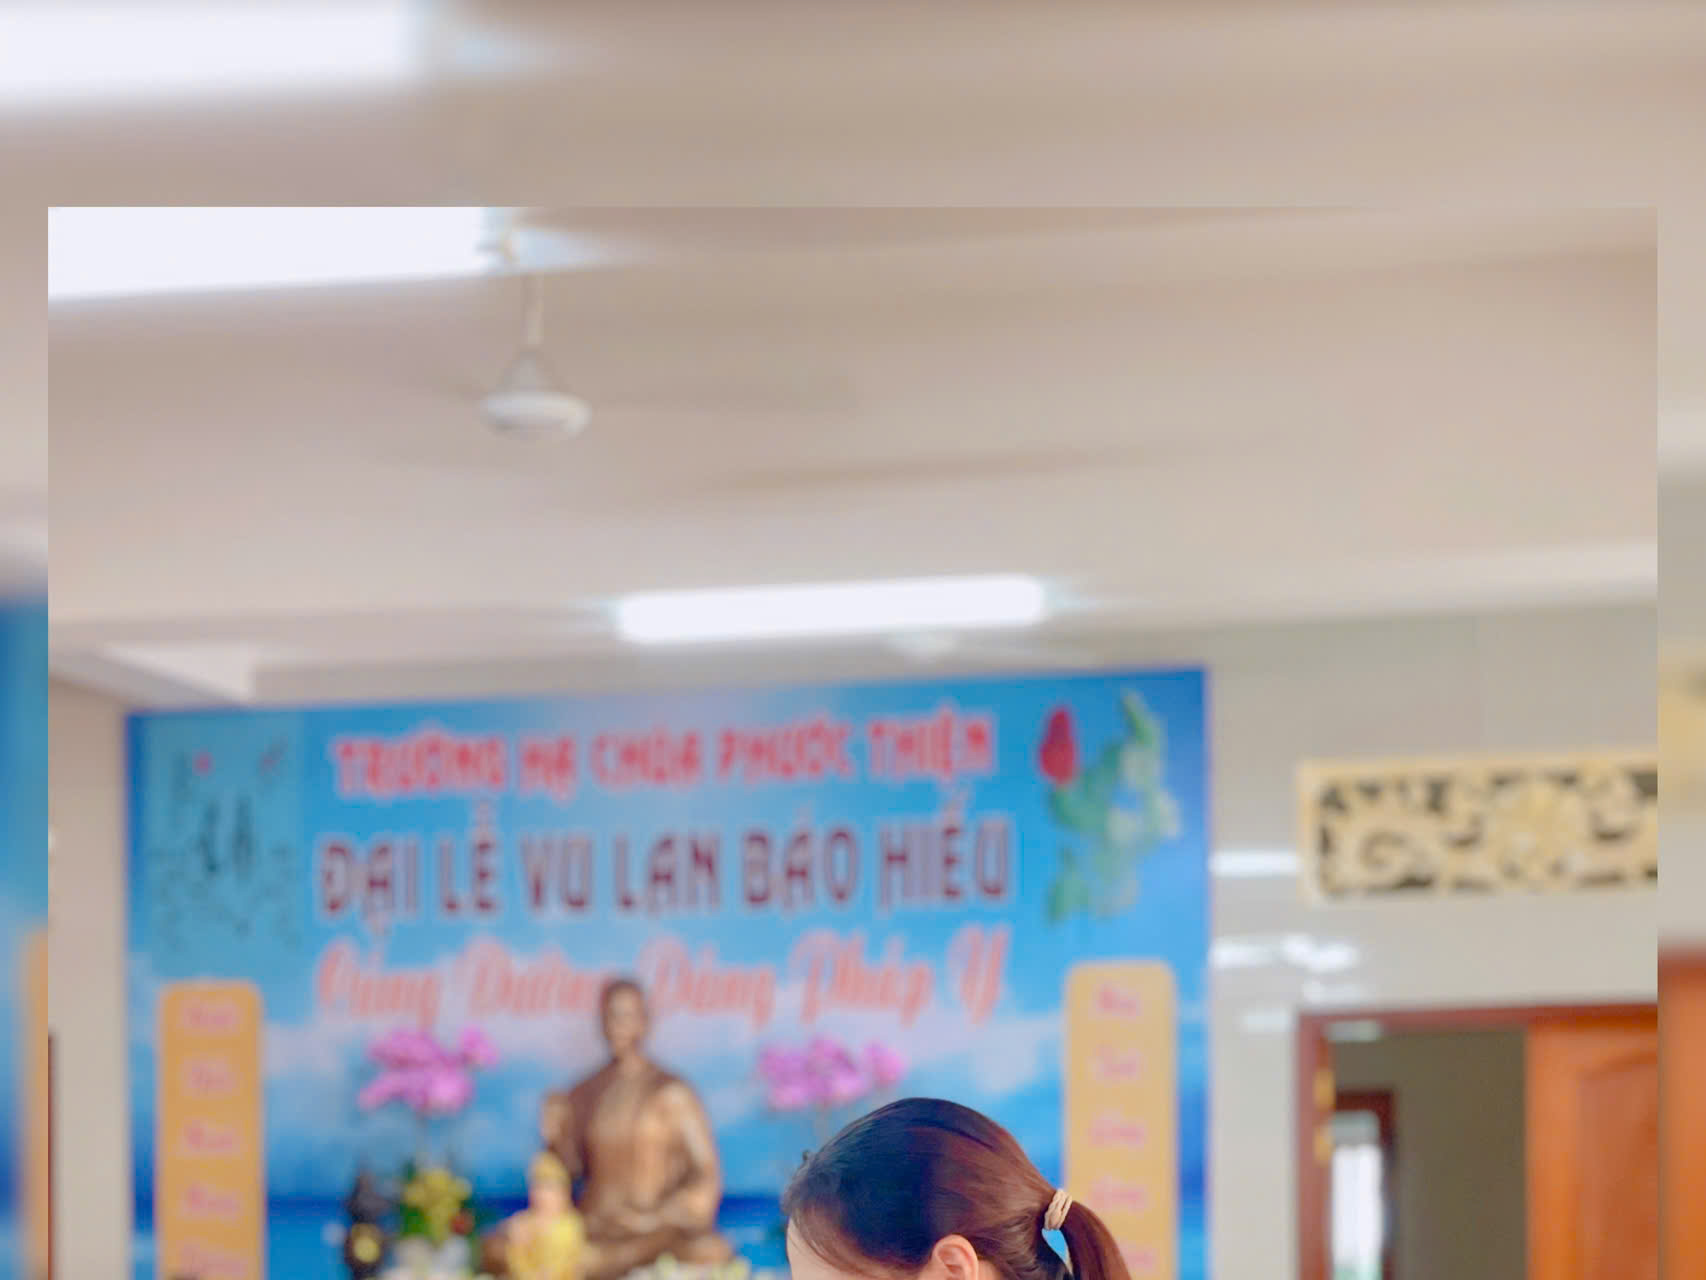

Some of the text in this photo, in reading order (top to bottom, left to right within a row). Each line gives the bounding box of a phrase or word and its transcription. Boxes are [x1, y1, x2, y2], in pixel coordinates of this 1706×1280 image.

[317, 834, 421, 937] ĐẠI
[521, 834, 593, 916] VU
[611, 833, 722, 916] LAN
